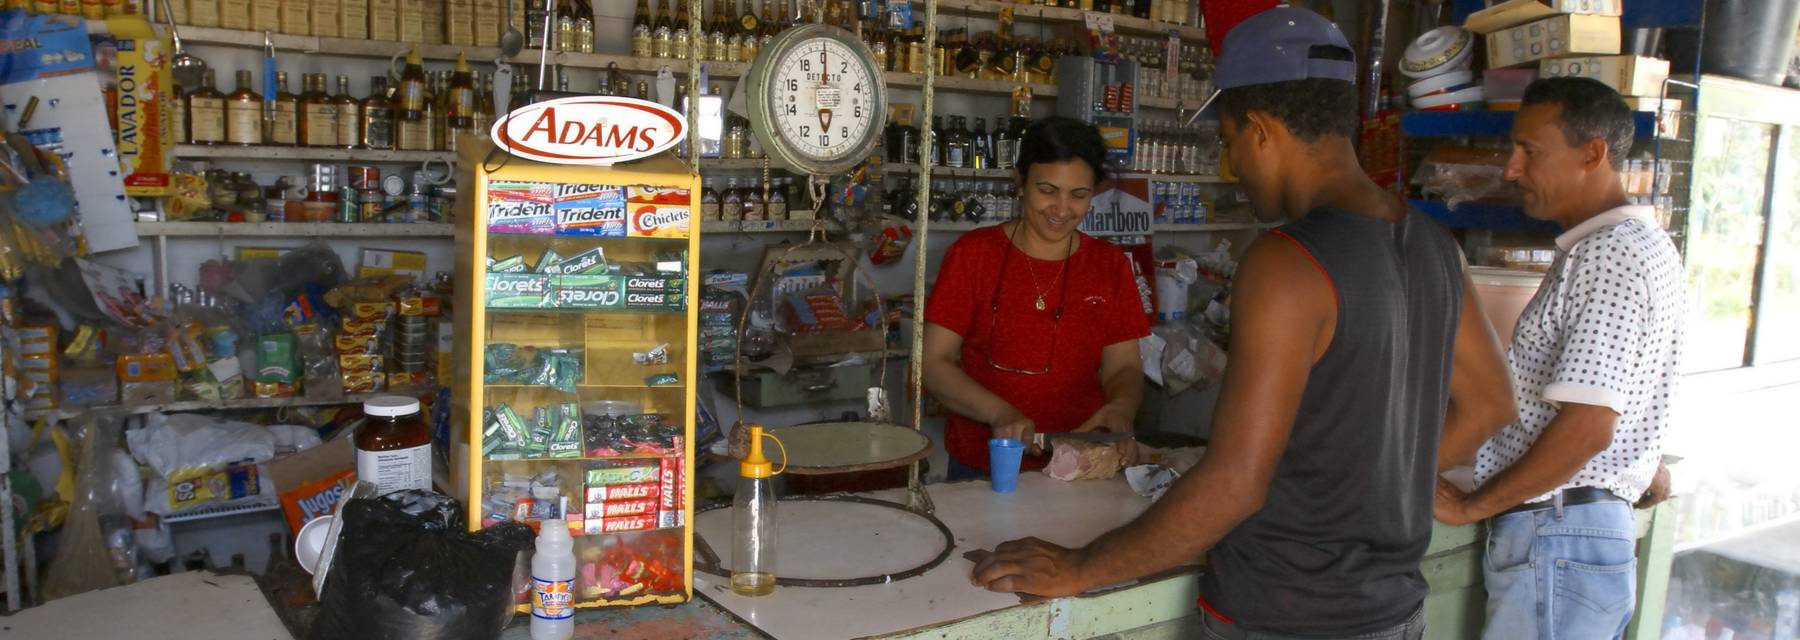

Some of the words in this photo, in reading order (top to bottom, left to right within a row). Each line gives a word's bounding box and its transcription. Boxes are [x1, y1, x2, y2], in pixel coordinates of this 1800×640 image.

[800, 60, 810, 71] 18
[841, 62, 847, 73] 2
[807, 73, 841, 82] DETCTO
[787, 79, 798, 91] 16
[854, 83, 860, 94] 4
[119, 65, 138, 155] LAVADOR
[786, 104, 796, 116] 14
[855, 106, 861, 118] 6
[799, 126, 810, 138] 12
[842, 127, 848, 138] 8
[819, 135, 829, 146] 10
[489, 201, 552, 219] Trident
[561, 207, 621, 222] Trident
[642, 210, 689, 228] Chiclets
[1081, 202, 1150, 232] Marlboro
[563, 255, 597, 274] Clorets
[628, 279, 664, 288] Clorets
[560, 289, 619, 305] Clorets
[628, 294, 664, 303] Clorets
[609, 487, 649, 499] HALLS
[663, 469, 673, 507] HALLS
[300, 484, 342, 521] Jugos
[606, 502, 646, 516] HALLS
[605, 519, 645, 532] HALLS
